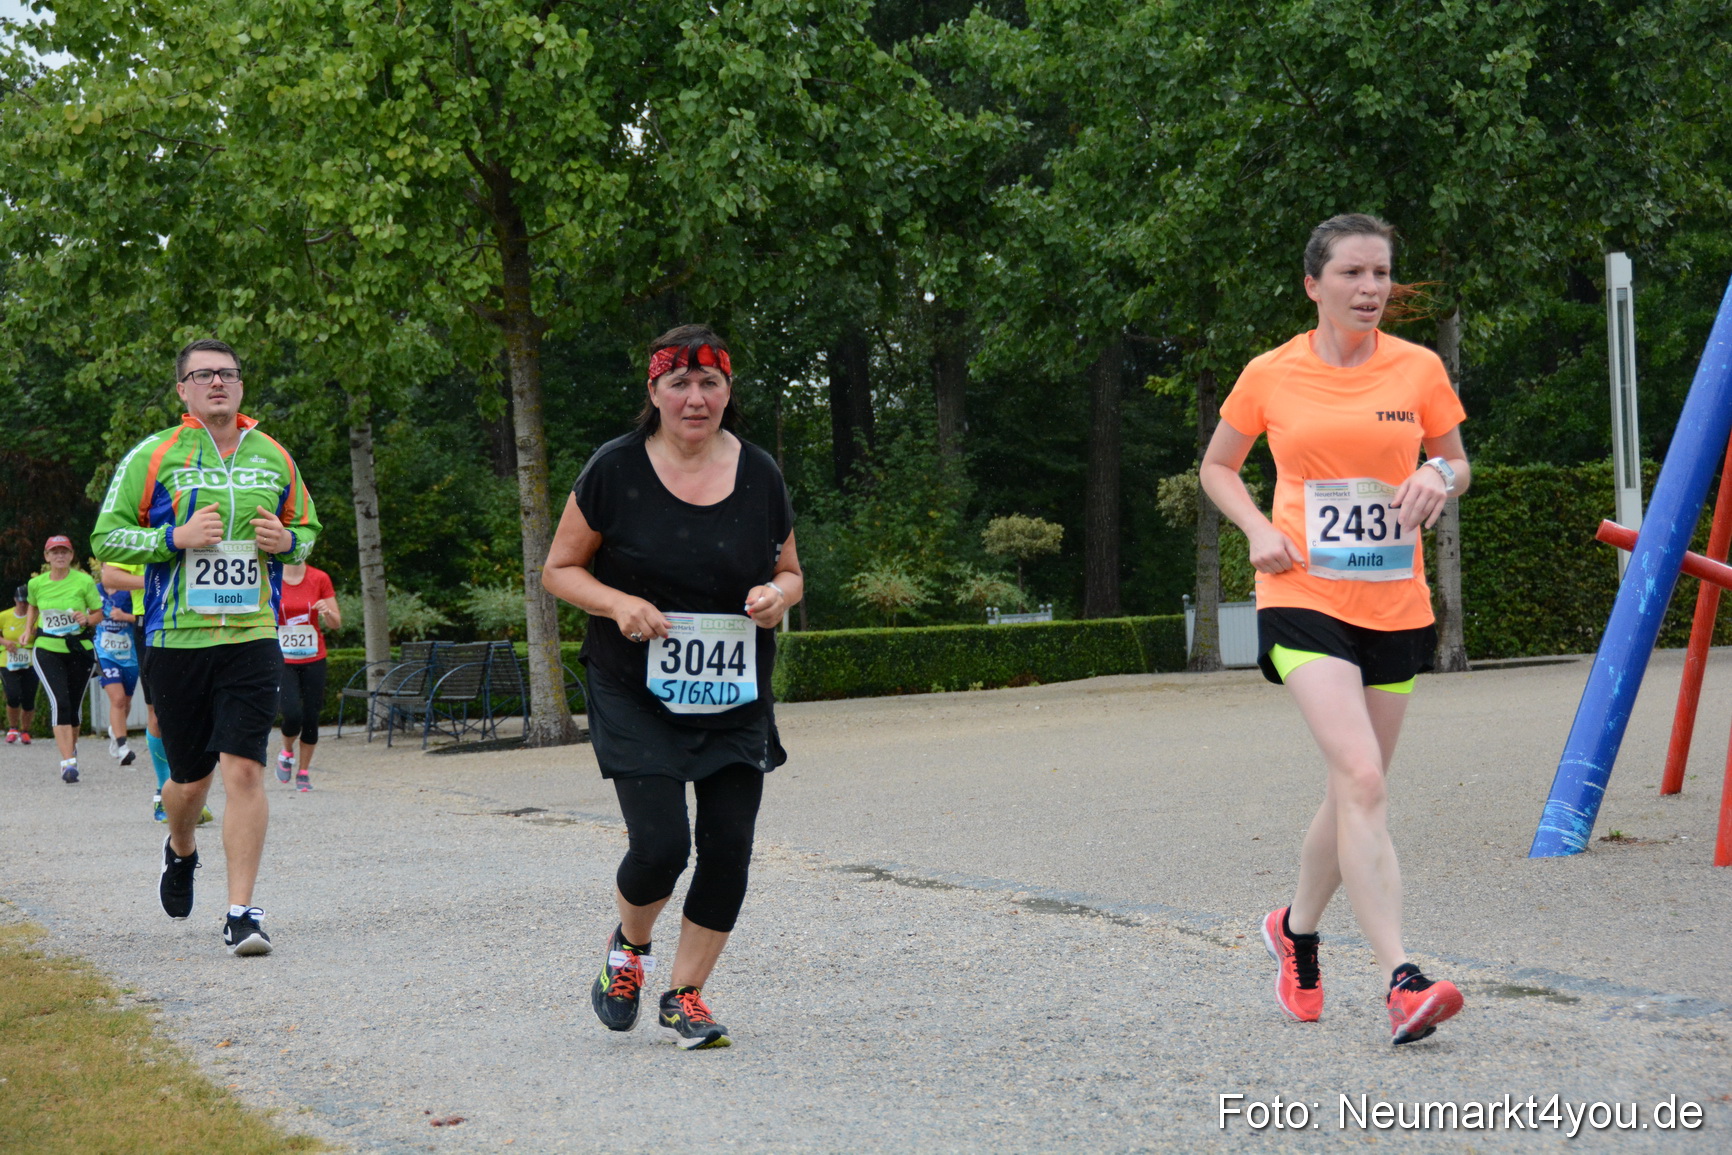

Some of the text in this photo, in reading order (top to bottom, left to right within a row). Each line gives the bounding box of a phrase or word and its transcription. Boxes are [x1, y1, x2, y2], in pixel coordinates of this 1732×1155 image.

[173, 467, 281, 492] BOCK
[1319, 504, 1402, 542] 2437
[1347, 552, 1384, 567] Anita
[195, 558, 258, 586] 2835
[214, 593, 243, 604] Iacob
[701, 618, 747, 630] BOCK
[282, 634, 313, 647] 2521
[660, 638, 747, 676] 3044
[103, 667, 120, 678] 22
[656, 679, 741, 705] SIGRID
